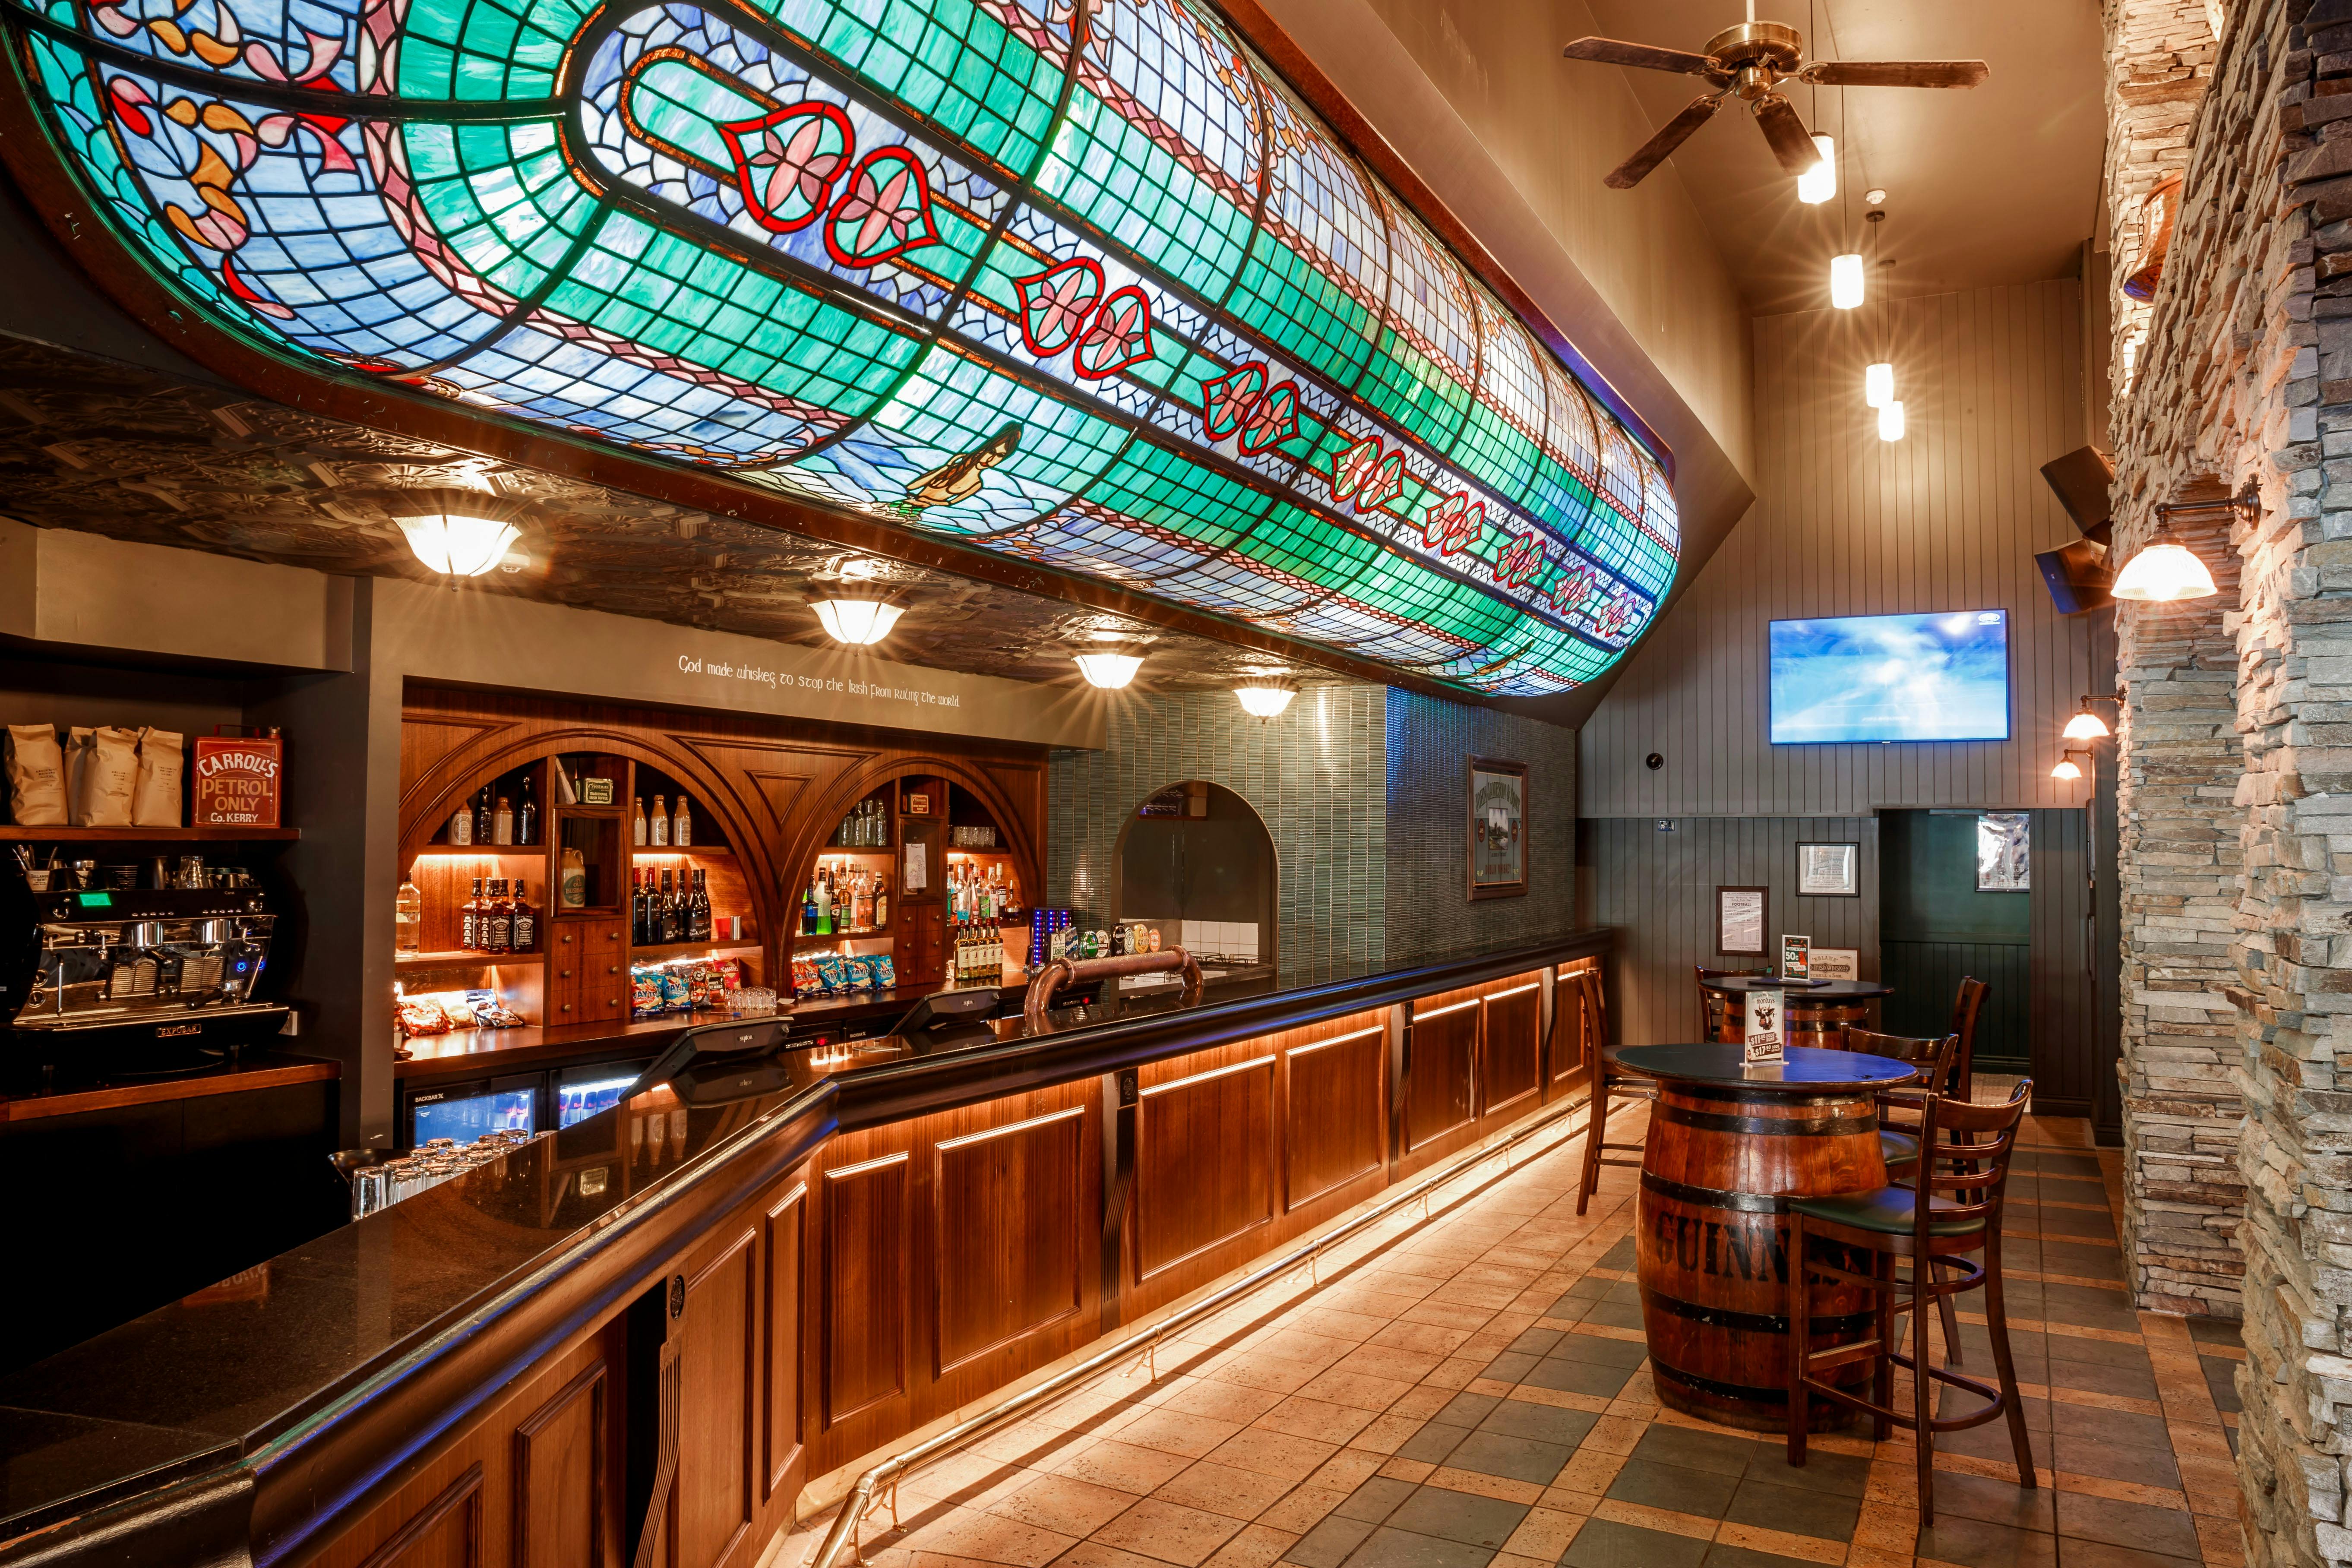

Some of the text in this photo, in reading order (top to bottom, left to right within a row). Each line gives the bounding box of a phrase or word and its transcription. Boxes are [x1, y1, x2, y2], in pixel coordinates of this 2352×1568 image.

[679, 655, 702, 673] God
[707, 662, 733, 677] made
[737, 664, 776, 689] whiskey
[780, 673, 793, 685] to
[798, 676, 823, 692] stop
[826, 677, 844, 692] the
[921, 692, 936, 704] the
[199, 753, 278, 778] CARROLL'S
[202, 779, 273, 799] PETROL
[215, 797, 260, 811] ONLY
[211, 812, 259, 823] Co. KERRY
[1786, 952, 1799, 961] 50c
[161, 1026, 196, 1035] EXPOBAR
[1655, 1211, 1871, 1286] GUINN
